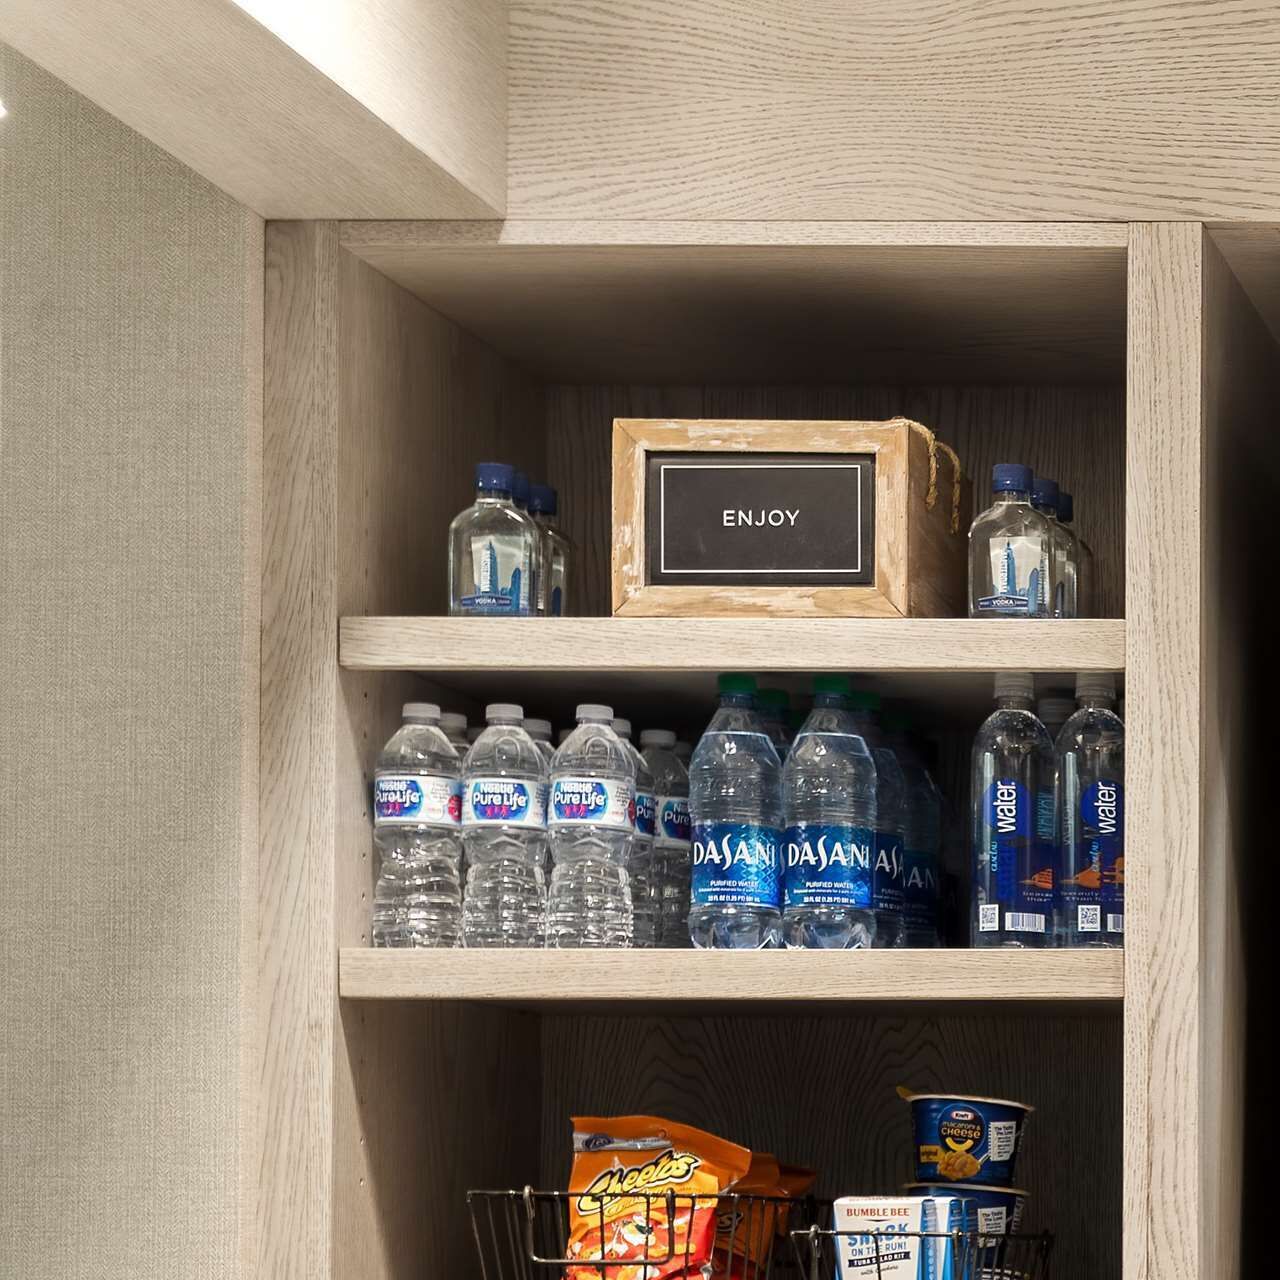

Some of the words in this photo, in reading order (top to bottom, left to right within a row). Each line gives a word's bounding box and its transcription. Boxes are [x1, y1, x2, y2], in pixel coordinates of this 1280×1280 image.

[722, 508, 800, 528] ENJOY
[693, 833, 775, 870] DASANI
[788, 835, 869, 871] DASANI
[577, 1149, 702, 1216] Cheetos
[846, 1207, 889, 1217] BUMBLE
[890, 1207, 910, 1217] BEE
[847, 1223, 910, 1247] SNACK
[851, 1248, 865, 1257] ON
[883, 1241, 907, 1254] RUN!
